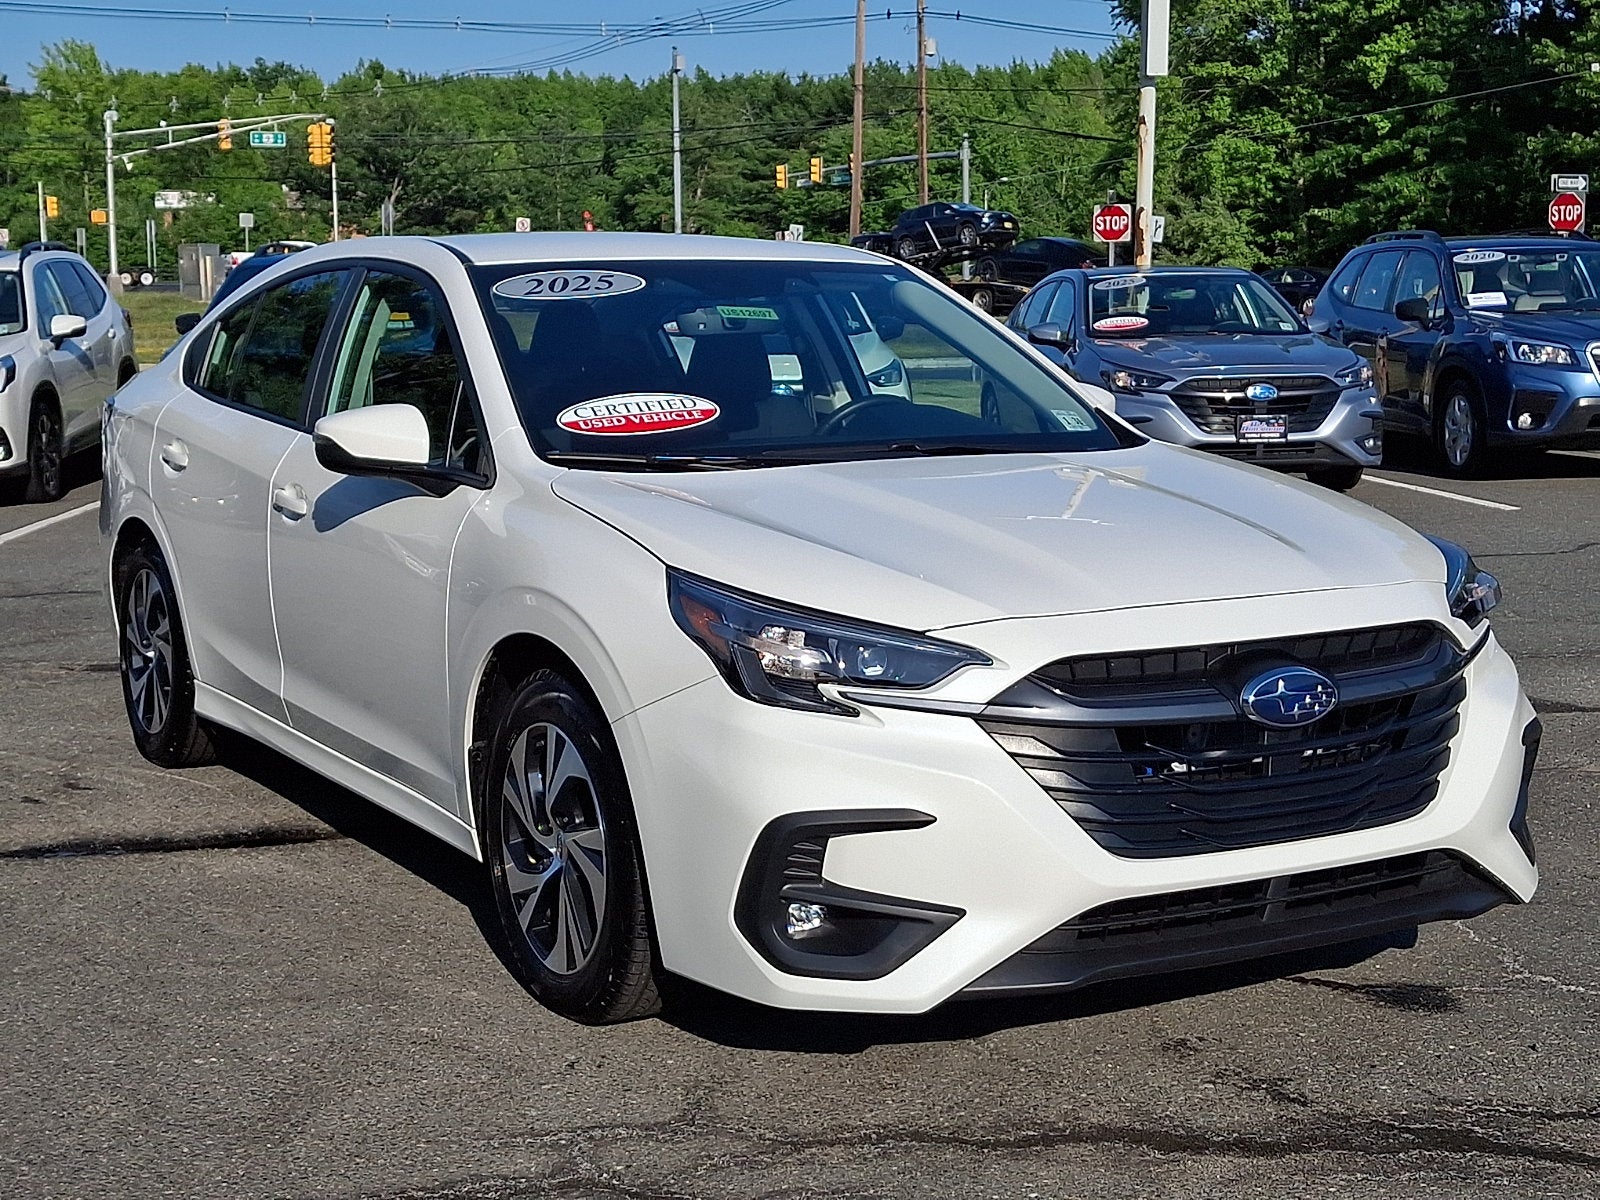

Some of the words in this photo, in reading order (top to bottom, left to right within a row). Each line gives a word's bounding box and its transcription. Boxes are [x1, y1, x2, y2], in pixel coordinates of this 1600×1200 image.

[1552, 205, 1581, 221] STOP
[1096, 216, 1128, 231] STOP
[1464, 252, 1495, 261] 2020
[524, 275, 614, 295] 2025
[1105, 279, 1135, 288] 2025
[573, 398, 697, 418] CERTIFIED
[578, 416, 626, 430] USED
[629, 409, 704, 424] VEHICLE
